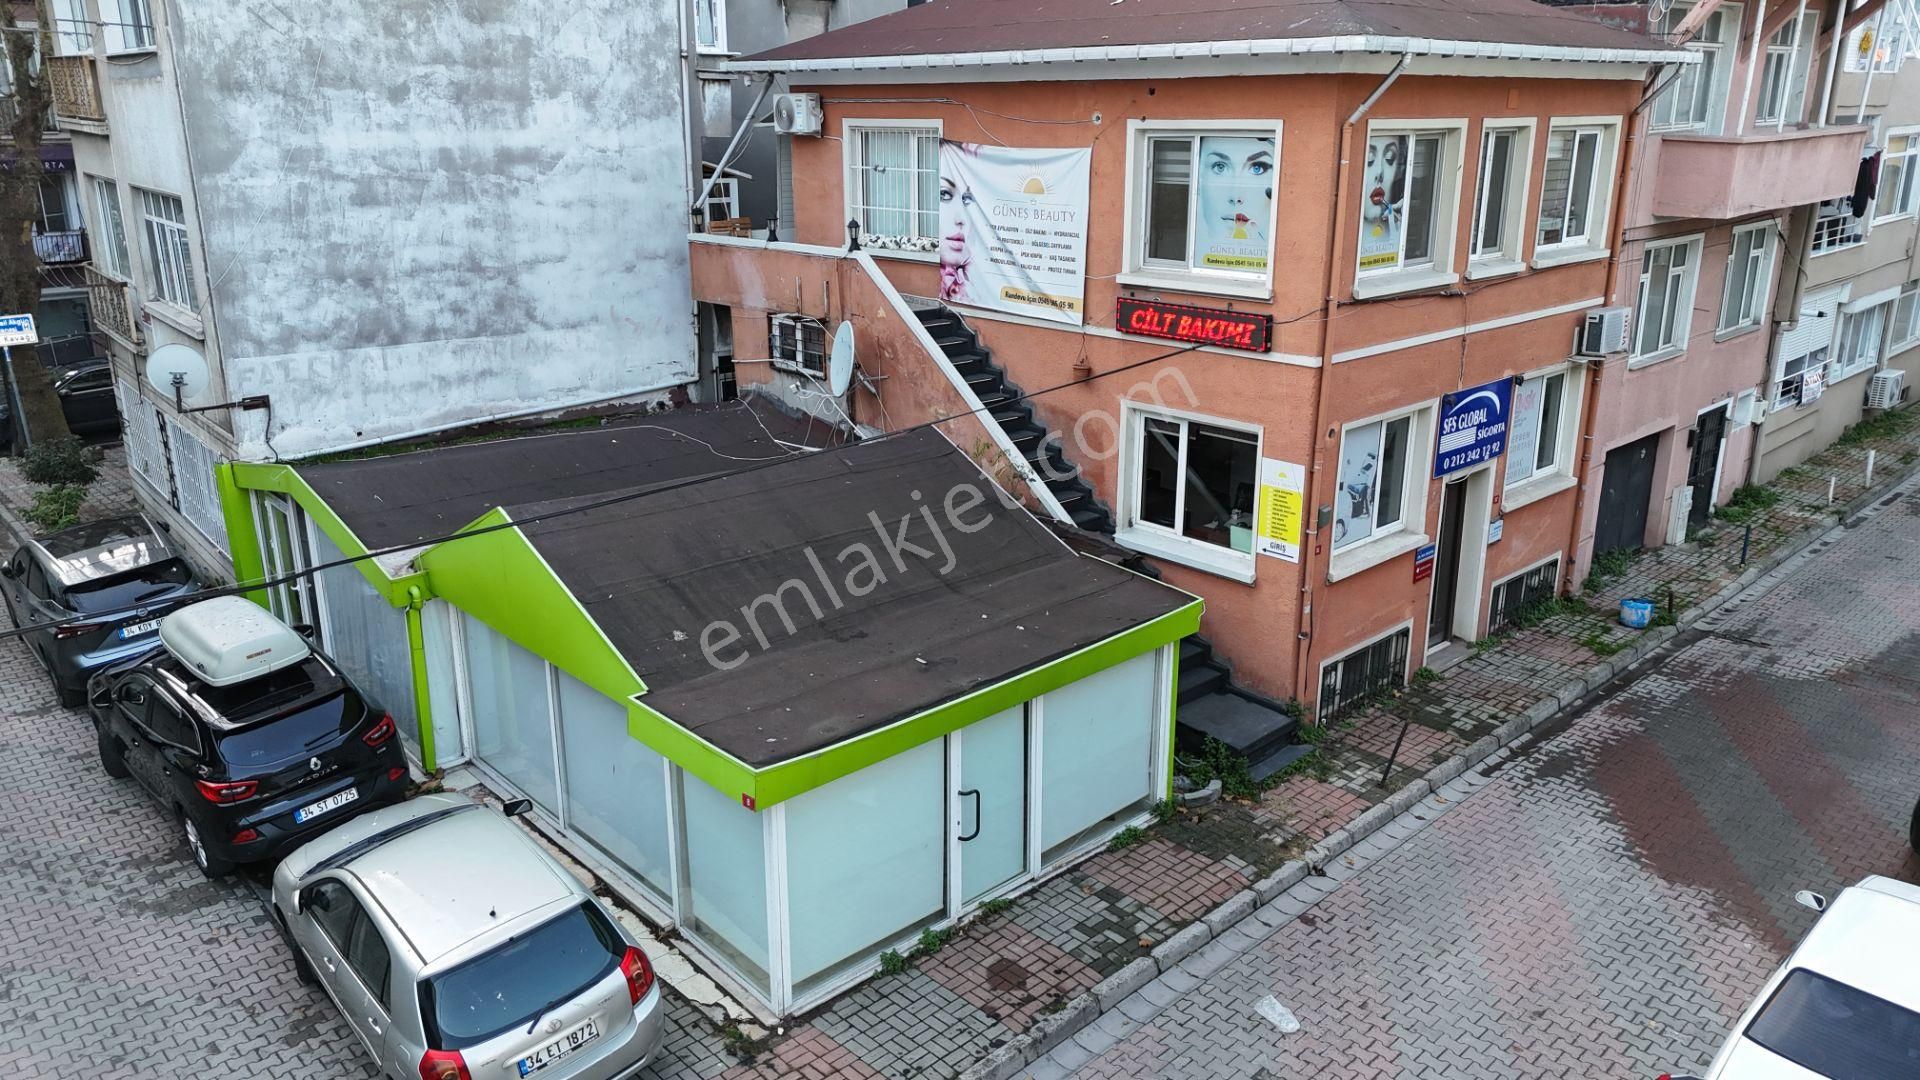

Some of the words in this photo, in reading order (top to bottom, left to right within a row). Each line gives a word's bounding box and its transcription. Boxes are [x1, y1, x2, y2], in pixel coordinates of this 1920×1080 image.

[993, 204, 1029, 220] GÜNEŞ
[1034, 208, 1076, 222] BEAUTY
[1130, 307, 1176, 333] CİLT
[1177, 315, 1257, 344] BAKIMI
[1443, 416, 1457, 434] SFS
[1458, 408, 1488, 429] GLOBAL
[1477, 422, 1506, 440] SİGORTA
[1443, 457, 1449, 470] 0
[1450, 453, 1465, 467] 212
[1466, 448, 1480, 462] 242
[1482, 444, 1491, 457] 12
[1491, 441, 1501, 453] 92
[302, 808, 314, 819] 34
[316, 800, 328, 813] ST
[332, 788, 356, 806] 0725
[526, 1051, 543, 1069] 34
[546, 1042, 562, 1058] ET
[566, 1023, 595, 1048] 1872
